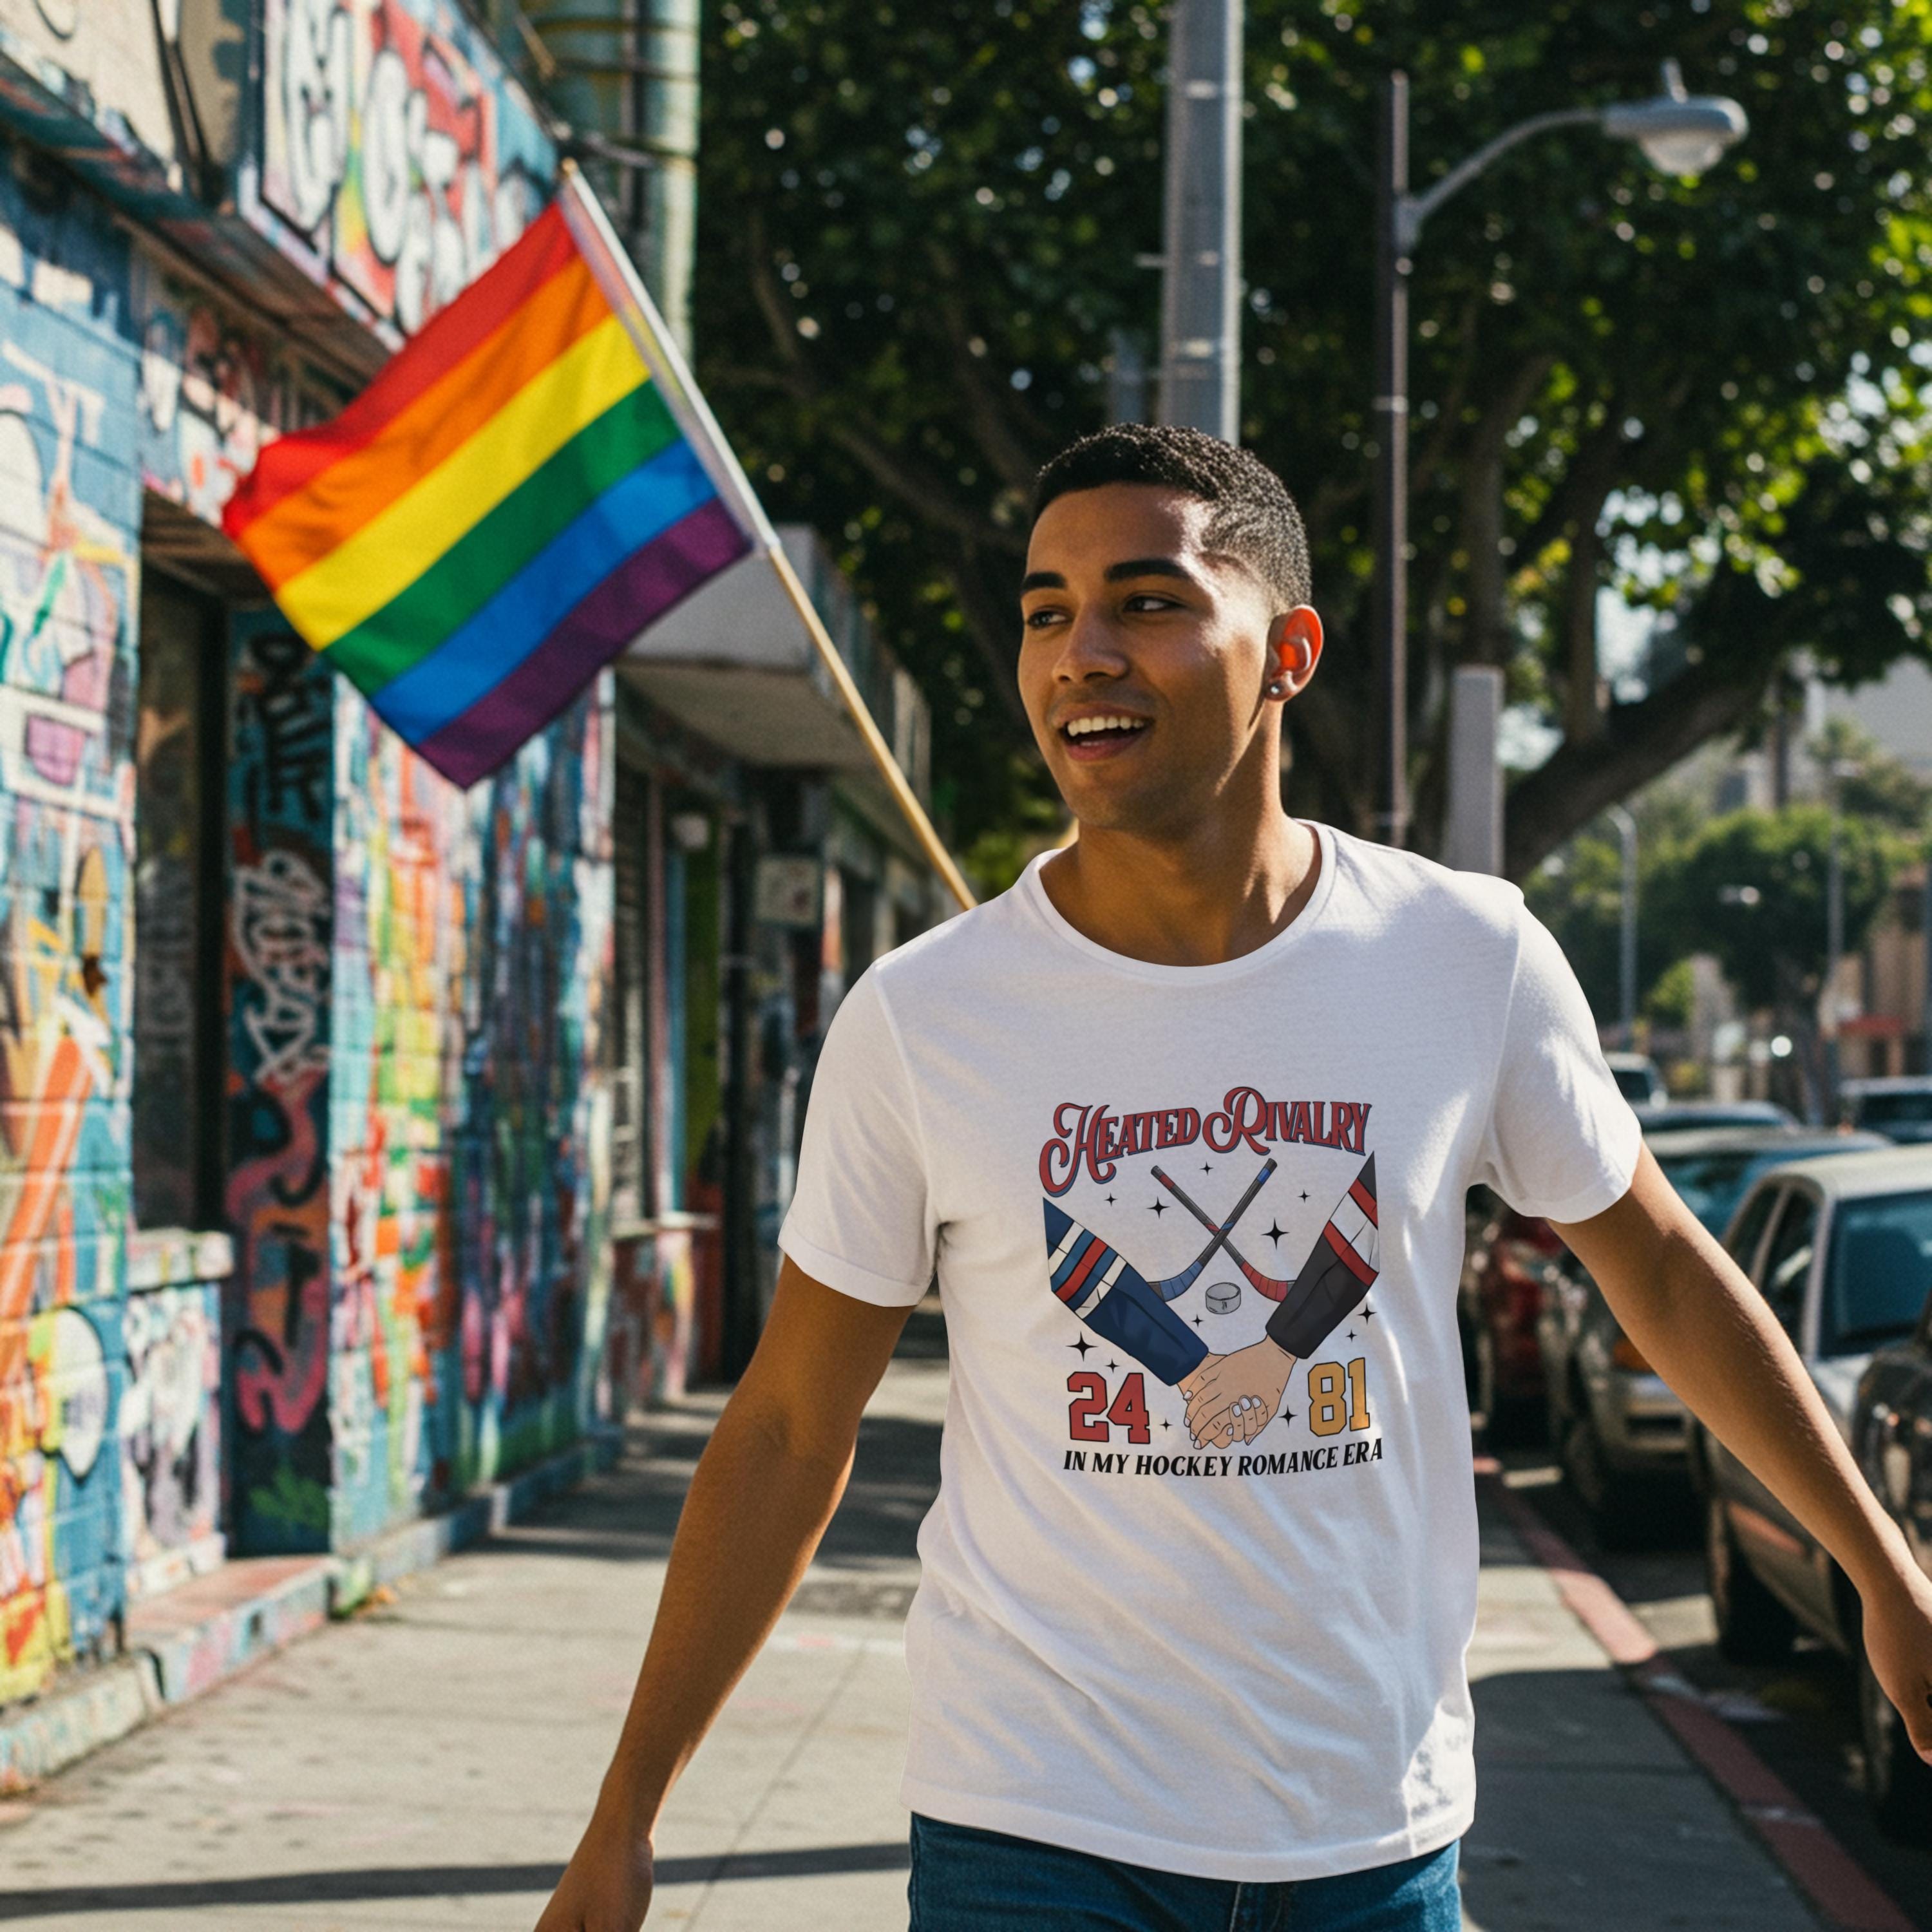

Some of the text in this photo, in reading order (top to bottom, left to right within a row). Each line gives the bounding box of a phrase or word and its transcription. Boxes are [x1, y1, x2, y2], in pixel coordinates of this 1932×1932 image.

[1039, 1086, 1372, 1197] HEATED RIVALRY
[1067, 1372, 1150, 1444] 24
[1308, 1357, 1370, 1437] 81
[1063, 1438, 1383, 1477] IN MY HOCKEY ROMANCE ERA
